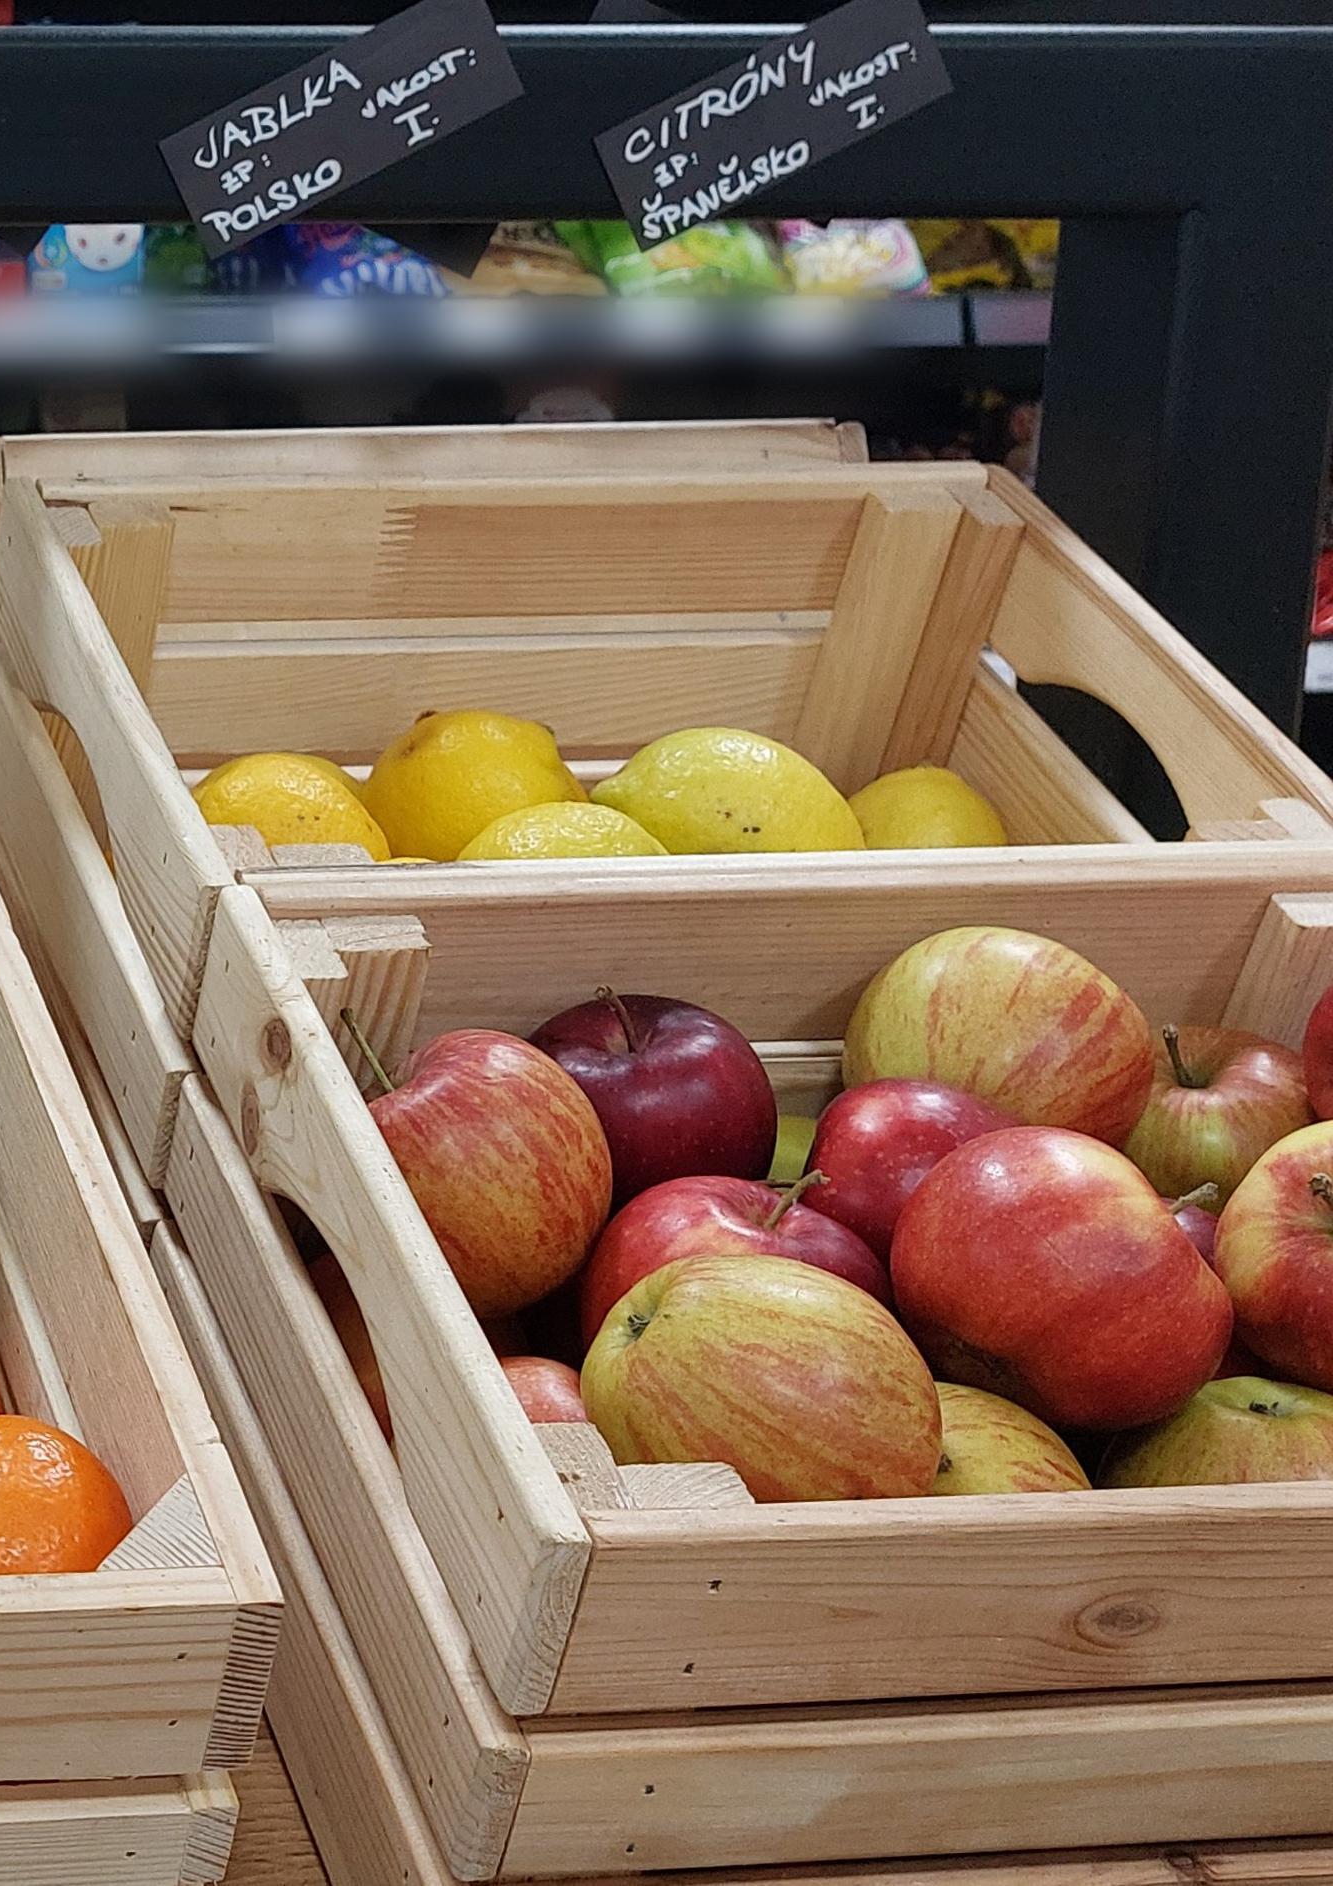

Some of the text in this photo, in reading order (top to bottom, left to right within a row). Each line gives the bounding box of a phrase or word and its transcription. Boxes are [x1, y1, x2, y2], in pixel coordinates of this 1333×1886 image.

[360, 47, 478, 120] JAKOST:
[623, 40, 817, 164] CITRÓNY
[808, 41, 918, 108] JAKOST:
[845, 93, 886, 131] I.
[193, 59, 362, 170] JABLKA
[393, 102, 441, 147] I.
[201, 158, 343, 243] POLSKO
[642, 139, 811, 240] ŠPANĚLSKO
